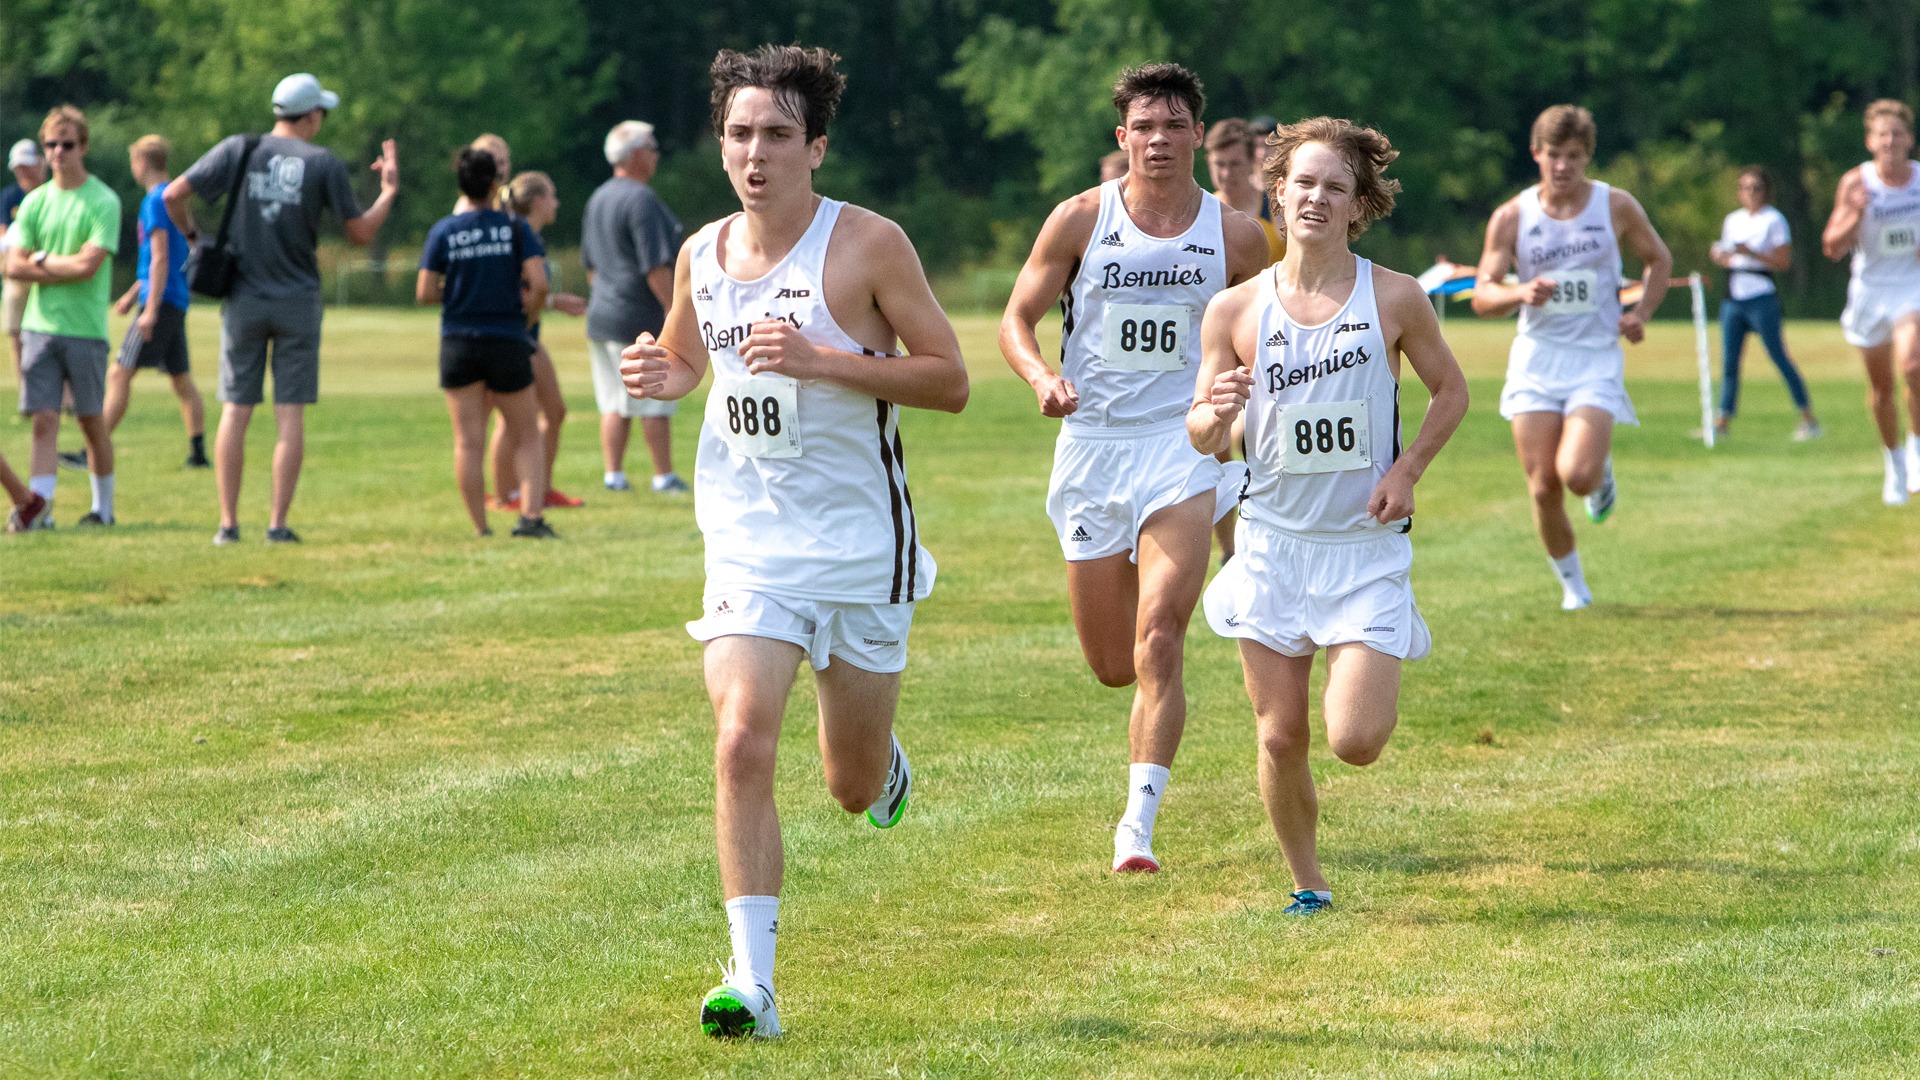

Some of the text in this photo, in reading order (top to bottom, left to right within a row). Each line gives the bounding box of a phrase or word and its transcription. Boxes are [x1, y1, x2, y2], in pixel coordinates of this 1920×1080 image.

[1101, 238, 1125, 248] adidas
[1182, 243, 1215, 256] A10
[1101, 262, 1207, 289] Bonnies
[774, 288, 810, 299] A10
[1121, 318, 1176, 353] 896
[1334, 322, 1370, 335] A10
[1265, 339, 1289, 347] adidas
[1266, 345, 1371, 394] Bonnies
[727, 395, 781, 436] 888
[1295, 416, 1355, 455] 886
